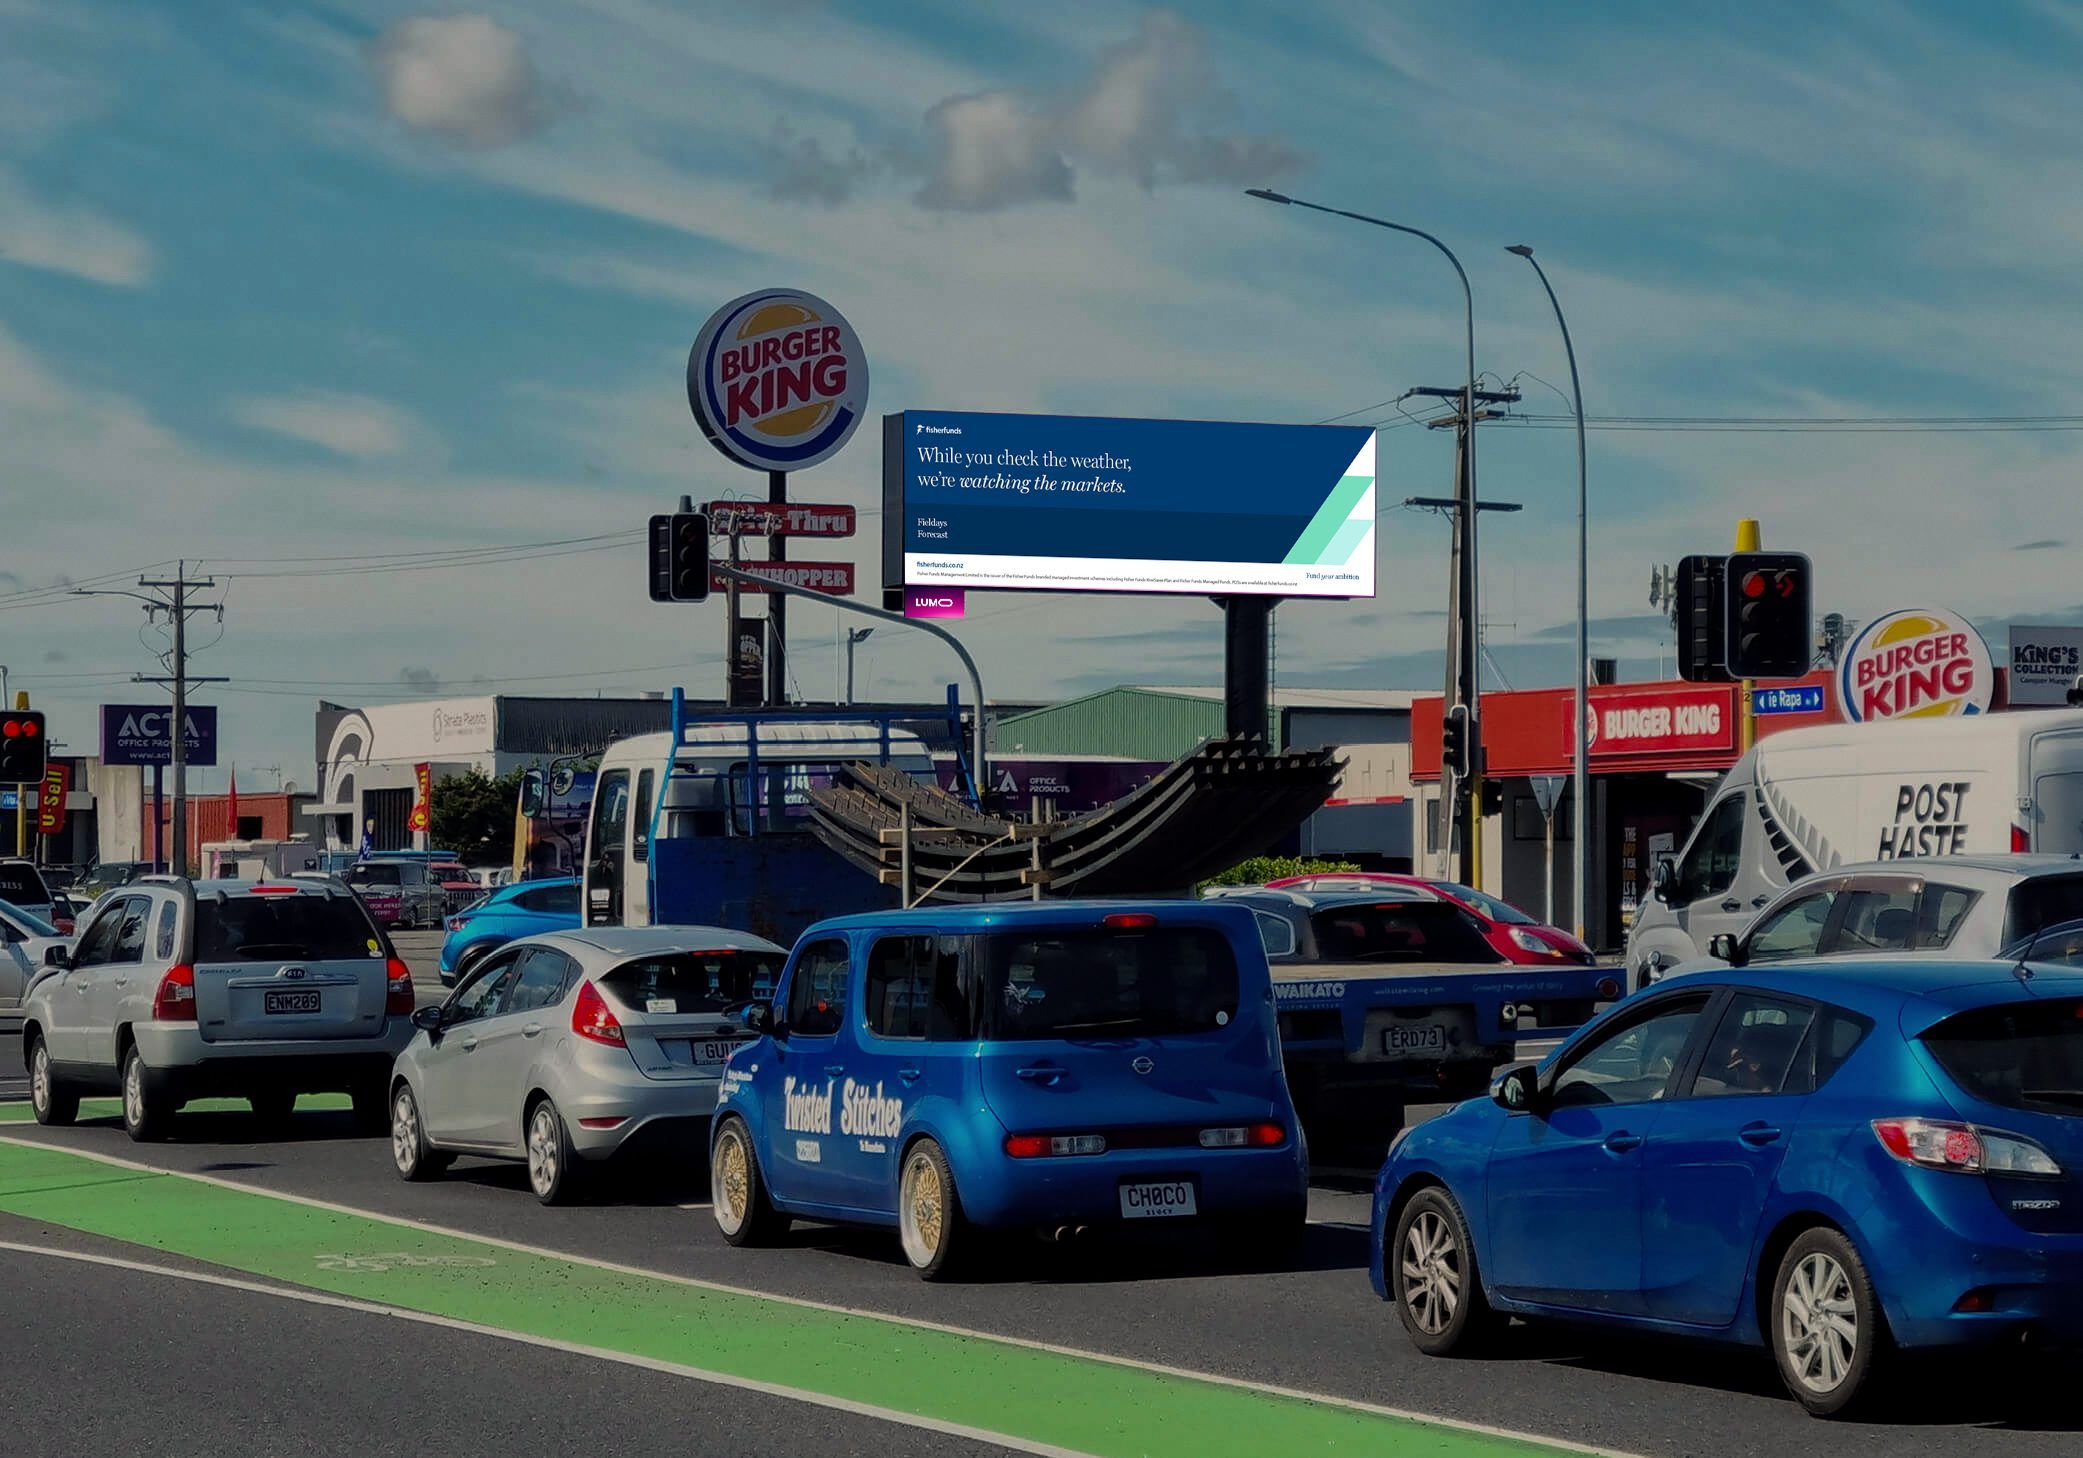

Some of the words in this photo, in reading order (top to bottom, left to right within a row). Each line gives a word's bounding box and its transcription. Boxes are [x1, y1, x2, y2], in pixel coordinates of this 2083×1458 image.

[722, 326, 841, 384] BURGER
[728, 355, 847, 426] KING
[925, 425, 962, 435] fisherfunds
[918, 447, 962, 465] While
[966, 452, 993, 468] you
[998, 449, 1038, 467] check
[1043, 451, 1066, 468] the
[1071, 453, 1132, 472] weather,
[960, 474, 1031, 494] watching
[1035, 475, 1057, 491] the
[1061, 477, 1125, 493] markets.
[788, 509, 847, 532] Thru
[918, 518, 948, 528] Fieldays
[918, 530, 948, 539] Forecast
[917, 561, 964, 569] fisherfunds.co.nz
[1858, 633, 1969, 688] BURGER
[2014, 664, 2079, 674] COLLECTION
[1779, 690, 1802, 710] Rapa
[1864, 658, 1974, 722] KING
[1604, 706, 1672, 740] BURGER
[1674, 703, 1721, 737] KING
[117, 739, 150, 748] OFFICE
[152, 739, 200, 748] PROCTS
[1895, 783, 1971, 824] POST
[1878, 825, 1968, 861] HASTE
[1274, 982, 1345, 999] WAIKATO
[1392, 1030, 1437, 1048] ERD73
[784, 1076, 834, 1135] Twisted
[840, 1076, 903, 1138] Stitches
